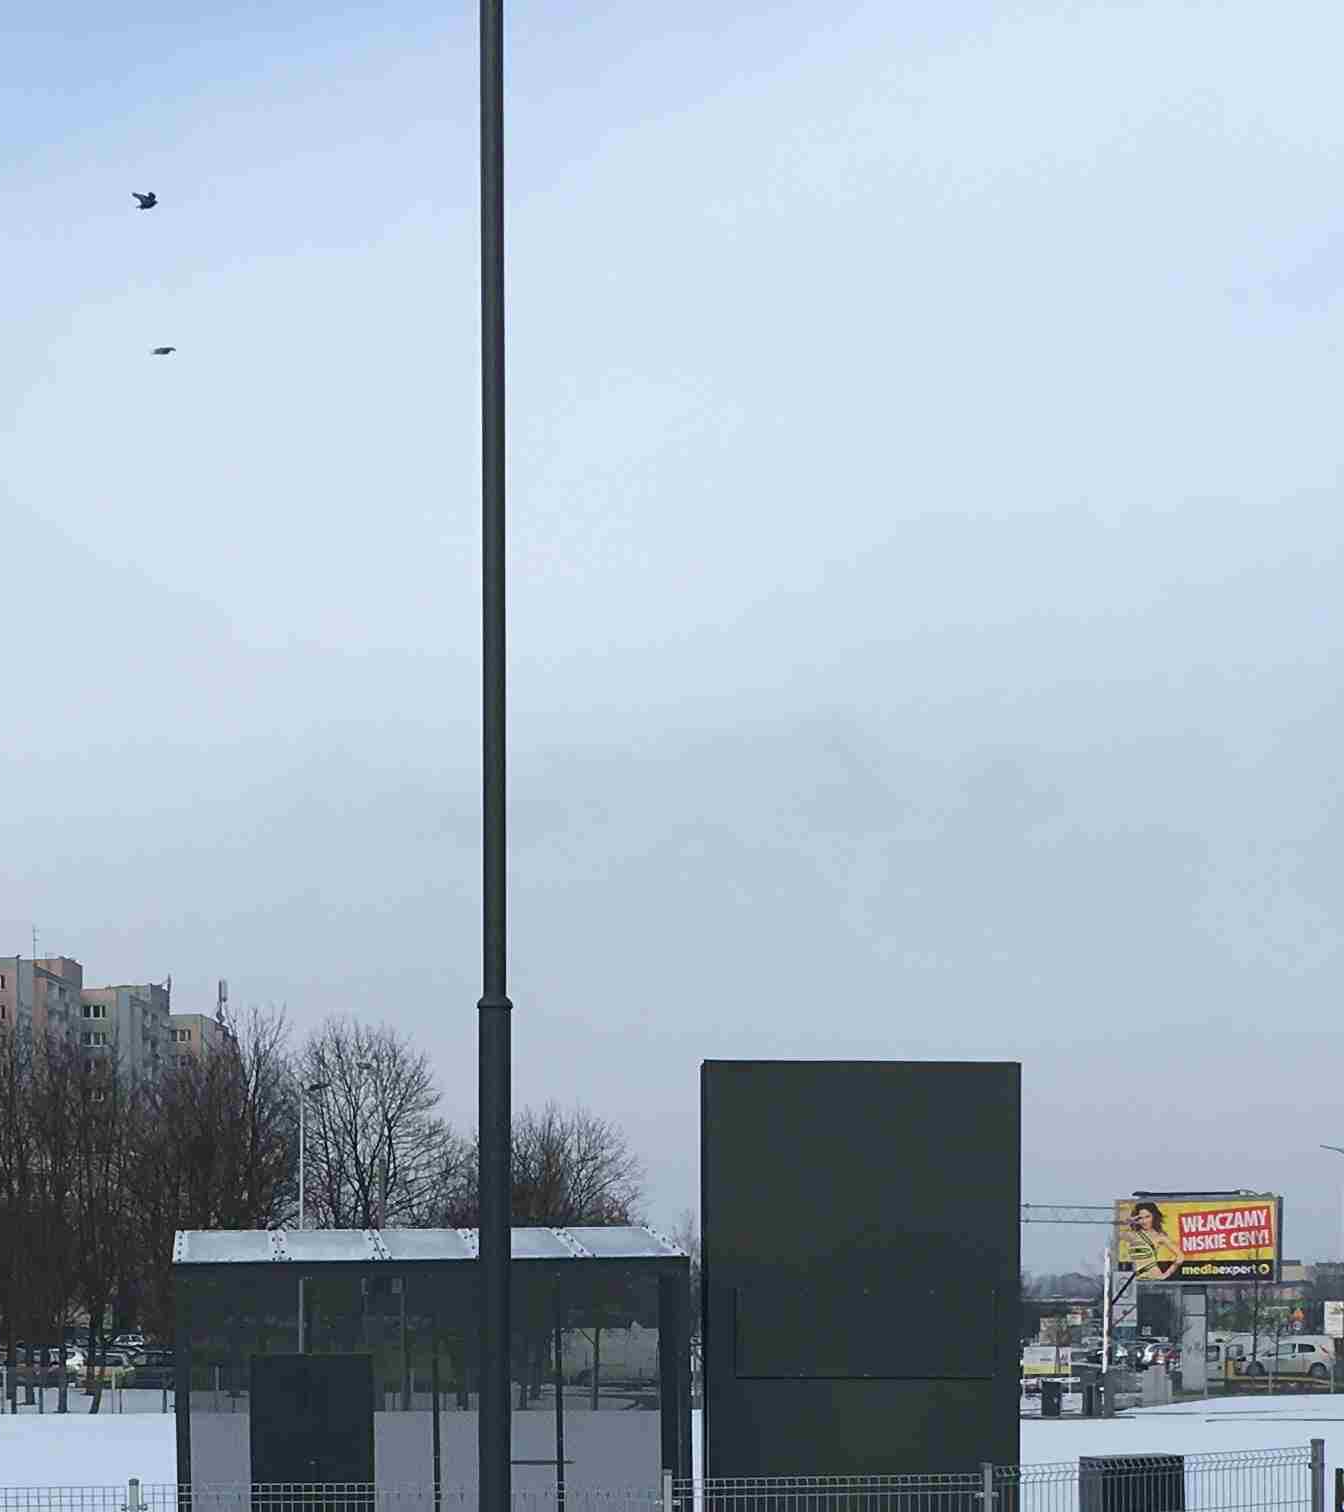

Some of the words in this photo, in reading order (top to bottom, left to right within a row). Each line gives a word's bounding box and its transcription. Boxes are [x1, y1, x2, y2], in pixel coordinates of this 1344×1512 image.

[1183, 1233, 1227, 1251] NISKIE
[1230, 1229, 1269, 1247] CENY!
[1182, 1264, 1256, 1276] mediaexpert
